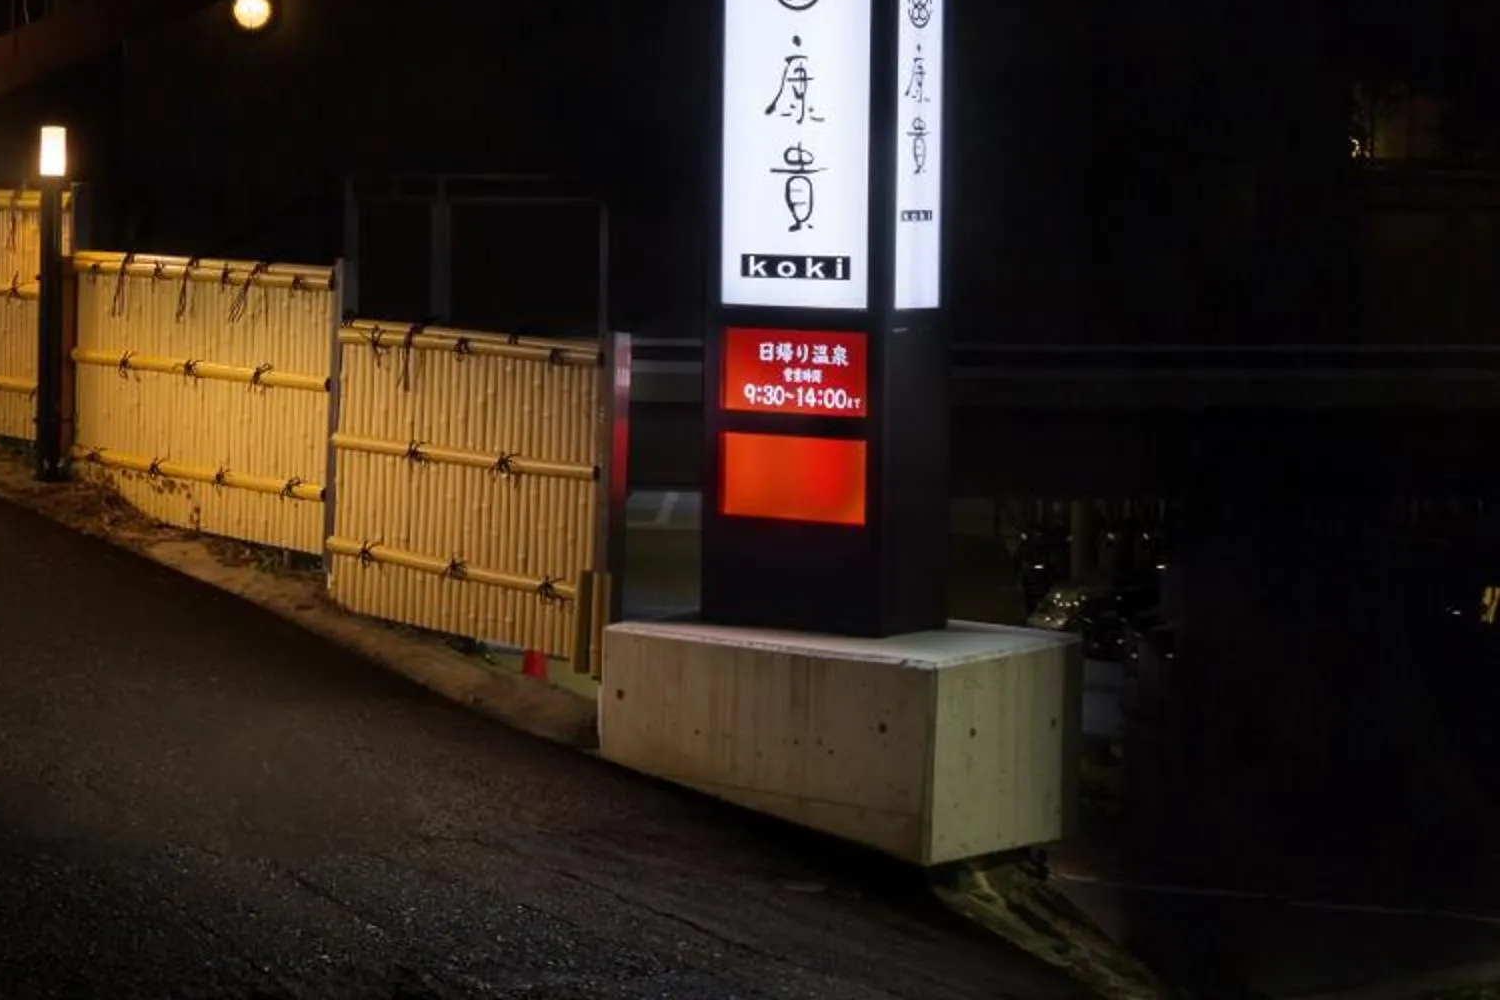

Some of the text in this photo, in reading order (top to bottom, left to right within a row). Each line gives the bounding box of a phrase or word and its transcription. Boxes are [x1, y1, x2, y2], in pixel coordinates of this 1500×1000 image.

[765, 34, 828, 232] 康貴
[748, 255, 844, 279] koki
[759, 342, 848, 366] 日帰り温泉
